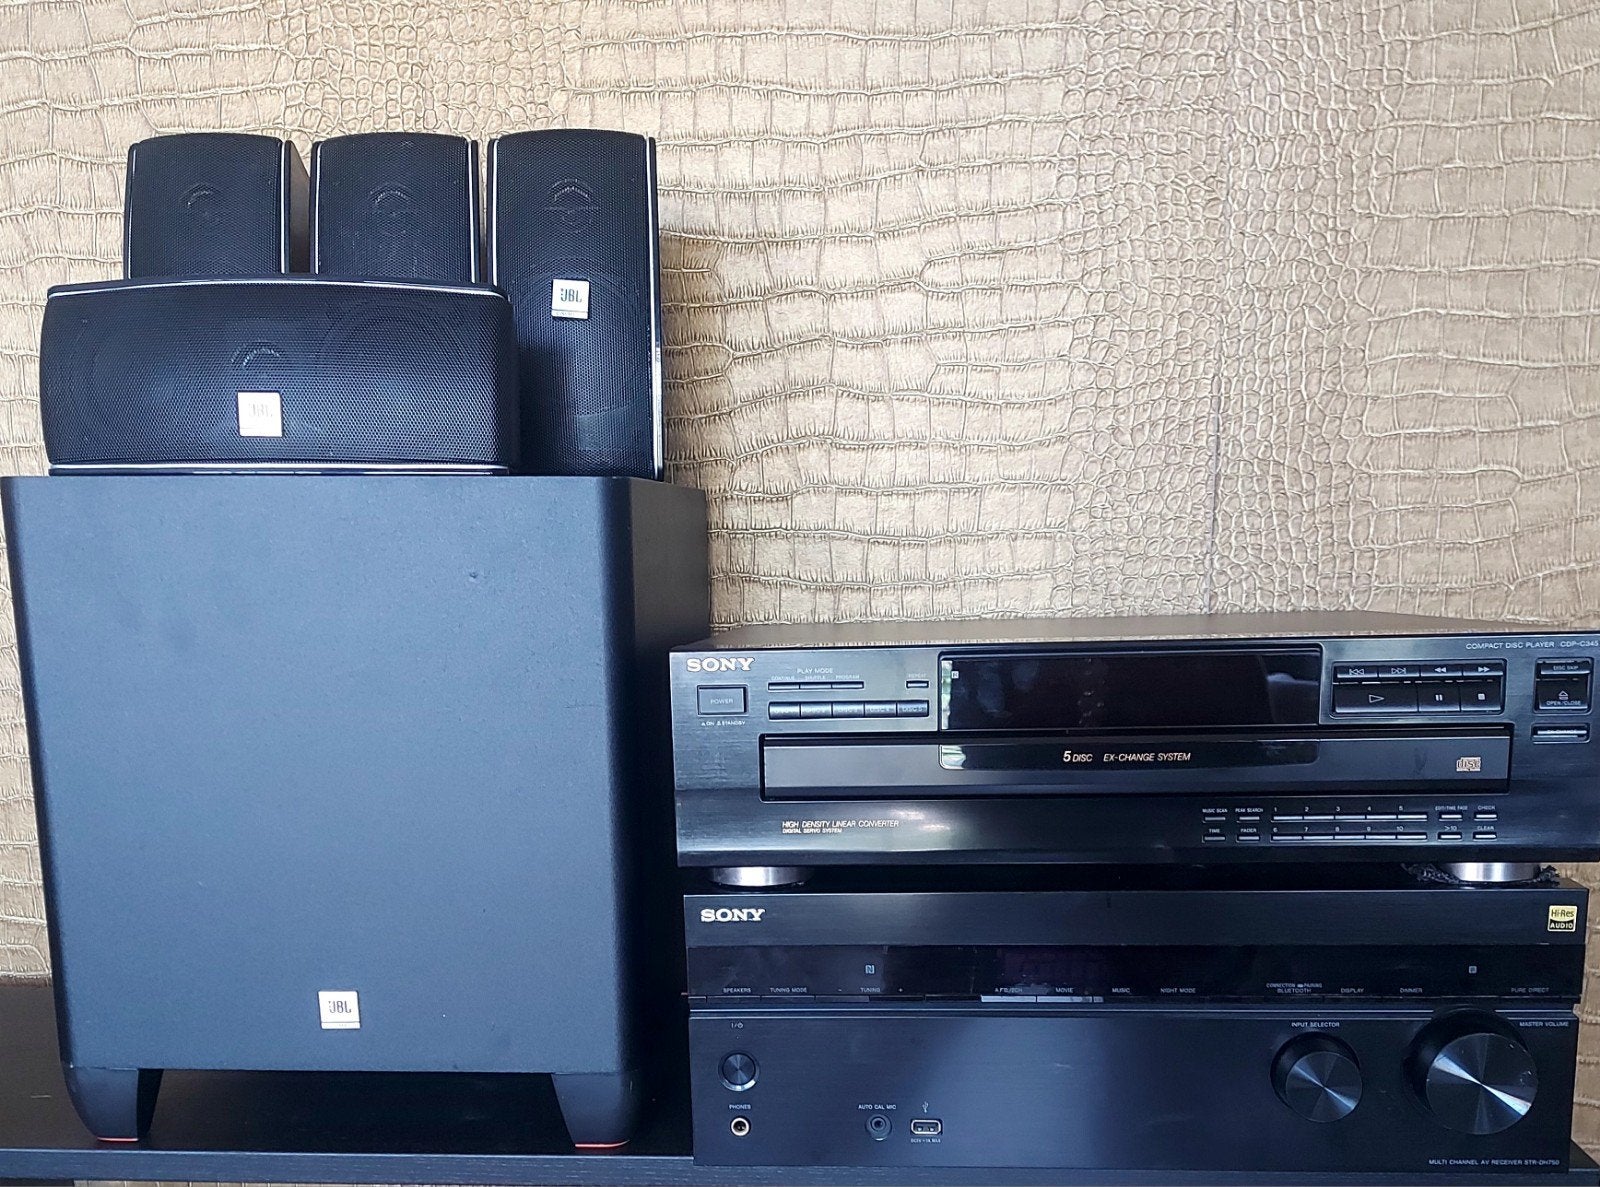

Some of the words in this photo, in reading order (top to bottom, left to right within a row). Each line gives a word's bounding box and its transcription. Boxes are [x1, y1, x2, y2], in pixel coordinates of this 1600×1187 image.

[560, 287, 583, 303] JBL
[248, 402, 274, 418] JBL
[1465, 642, 1503, 650] COMPACT
[686, 657, 755, 672] SONY
[1063, 750, 1071, 762] 5
[1072, 754, 1093, 762] DISC
[1103, 752, 1155, 762] EX-CHANGE
[1156, 752, 1191, 761] SYSTEM
[782, 820, 799, 828] HIGH
[801, 820, 830, 828] DENSITY
[831, 820, 856, 828] LINEAR
[858, 820, 899, 828] CONVERTER
[700, 908, 766, 922] SONY
[1551, 909, 1574, 918] Hi-Res
[328, 1000, 352, 1014] JBL
